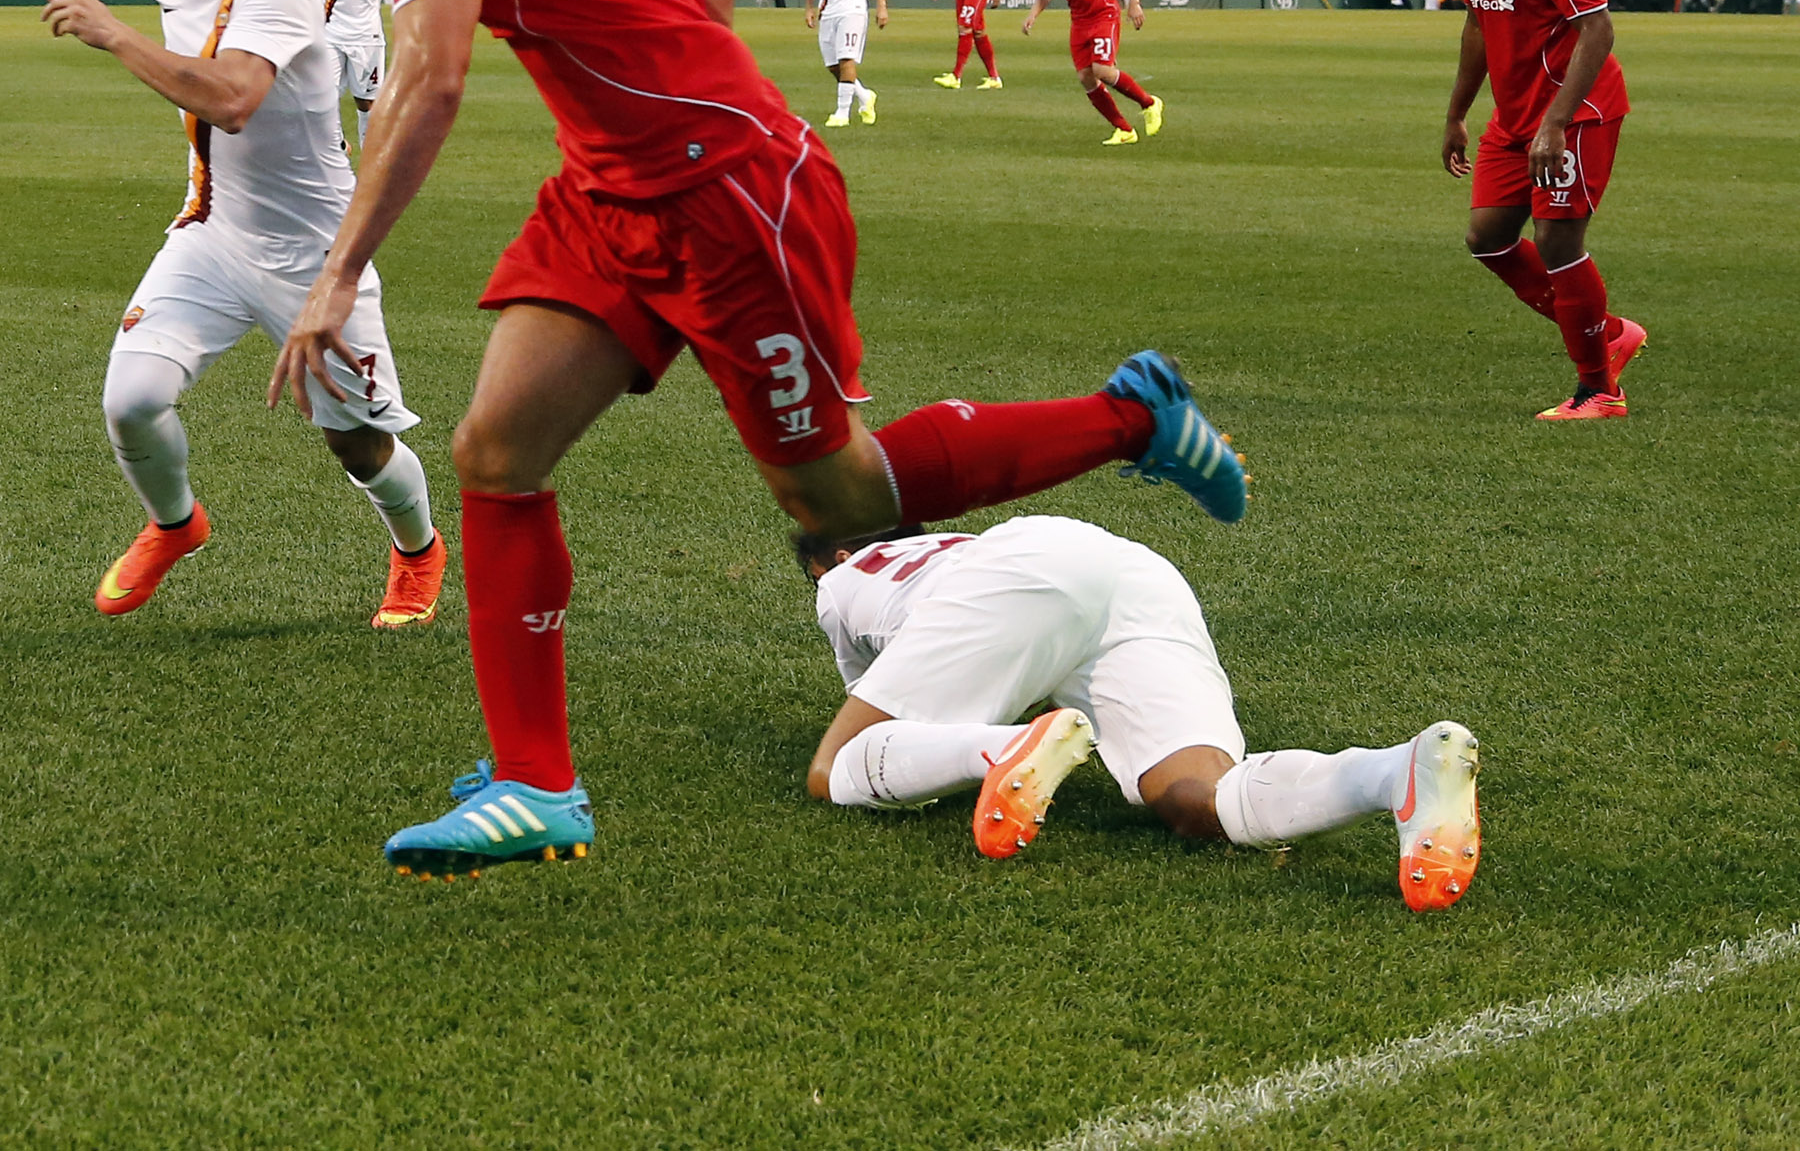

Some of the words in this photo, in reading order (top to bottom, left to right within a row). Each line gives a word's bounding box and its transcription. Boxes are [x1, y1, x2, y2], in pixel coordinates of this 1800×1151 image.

[845, 33, 858, 47] 10
[1094, 38, 1111, 54] 21
[370, 66, 378, 84] 4
[755, 333, 811, 408] 3
